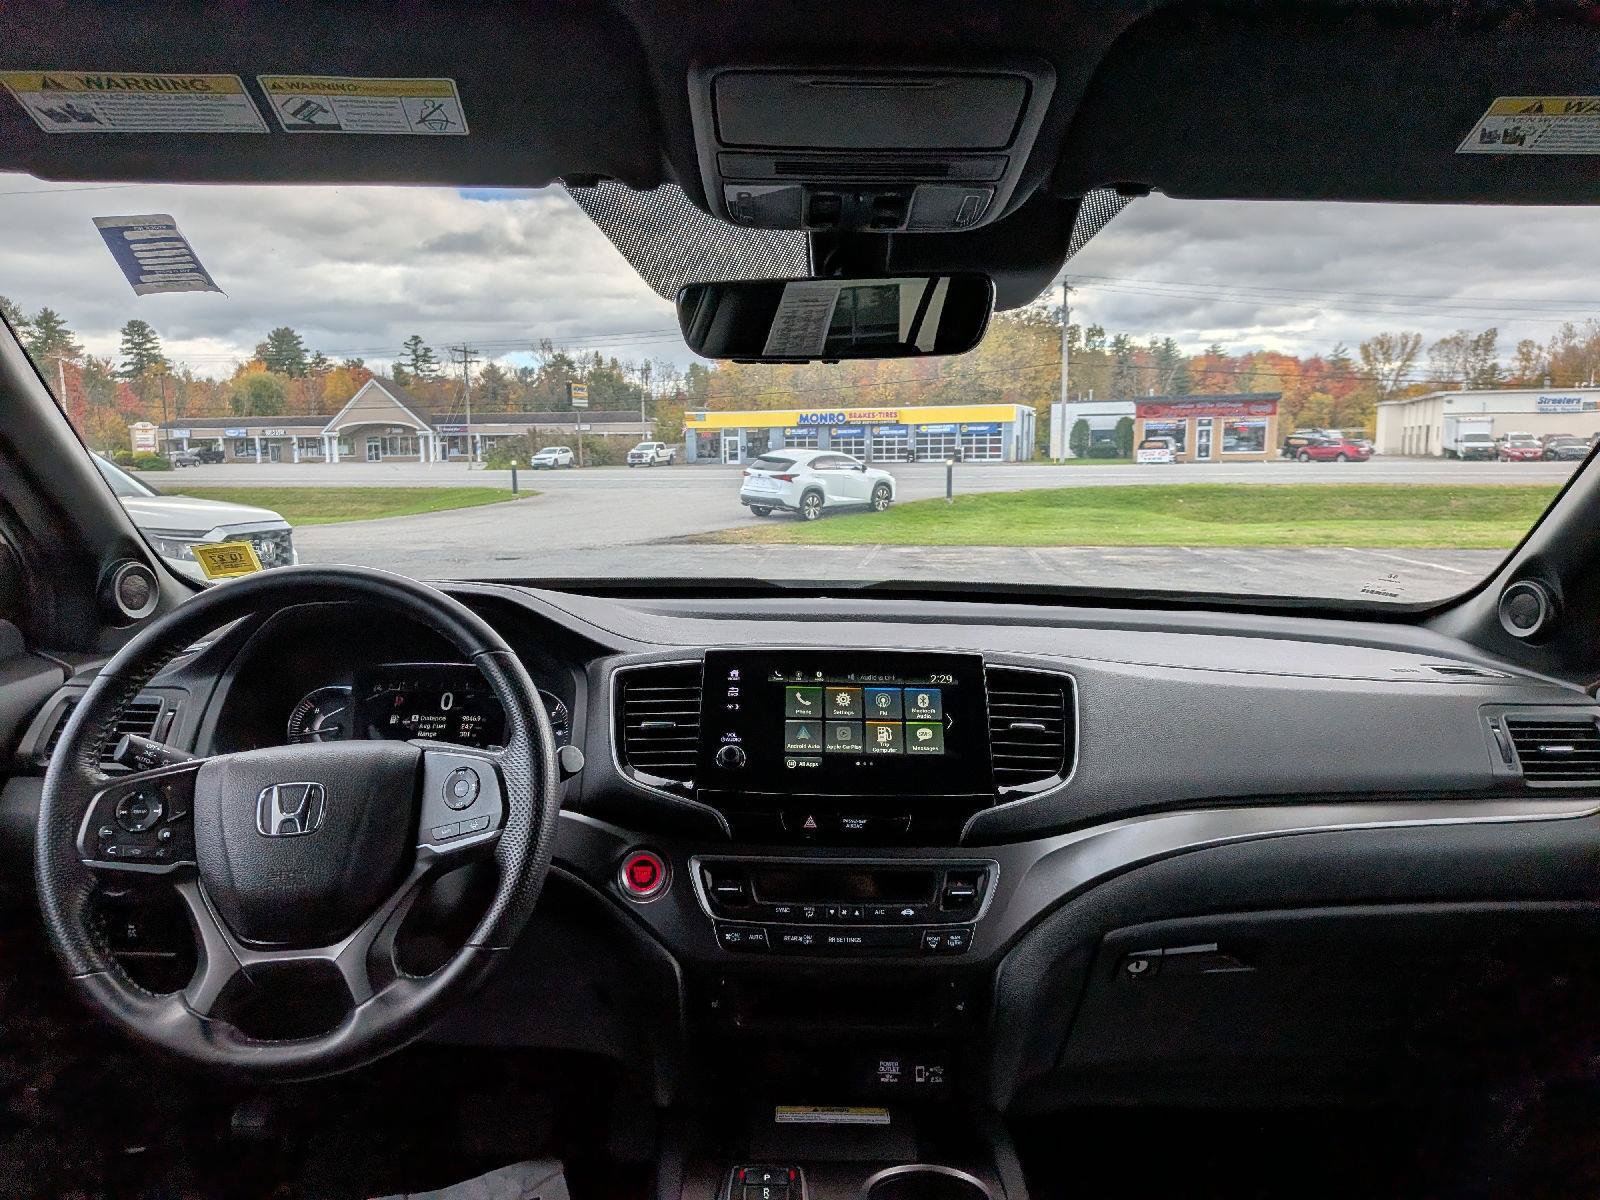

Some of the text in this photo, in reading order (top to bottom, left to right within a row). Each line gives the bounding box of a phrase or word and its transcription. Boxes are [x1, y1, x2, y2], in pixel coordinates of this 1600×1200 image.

[77, 76, 212, 91] WARNING
[286, 81, 360, 92] WARNING
[1537, 396, 1582, 405] Streeters
[798, 411, 847, 425] MONRO
[930, 674, 953, 684] 2:29
[441, 692, 454, 711] 0
[763, 1187, 770, 1197] R
